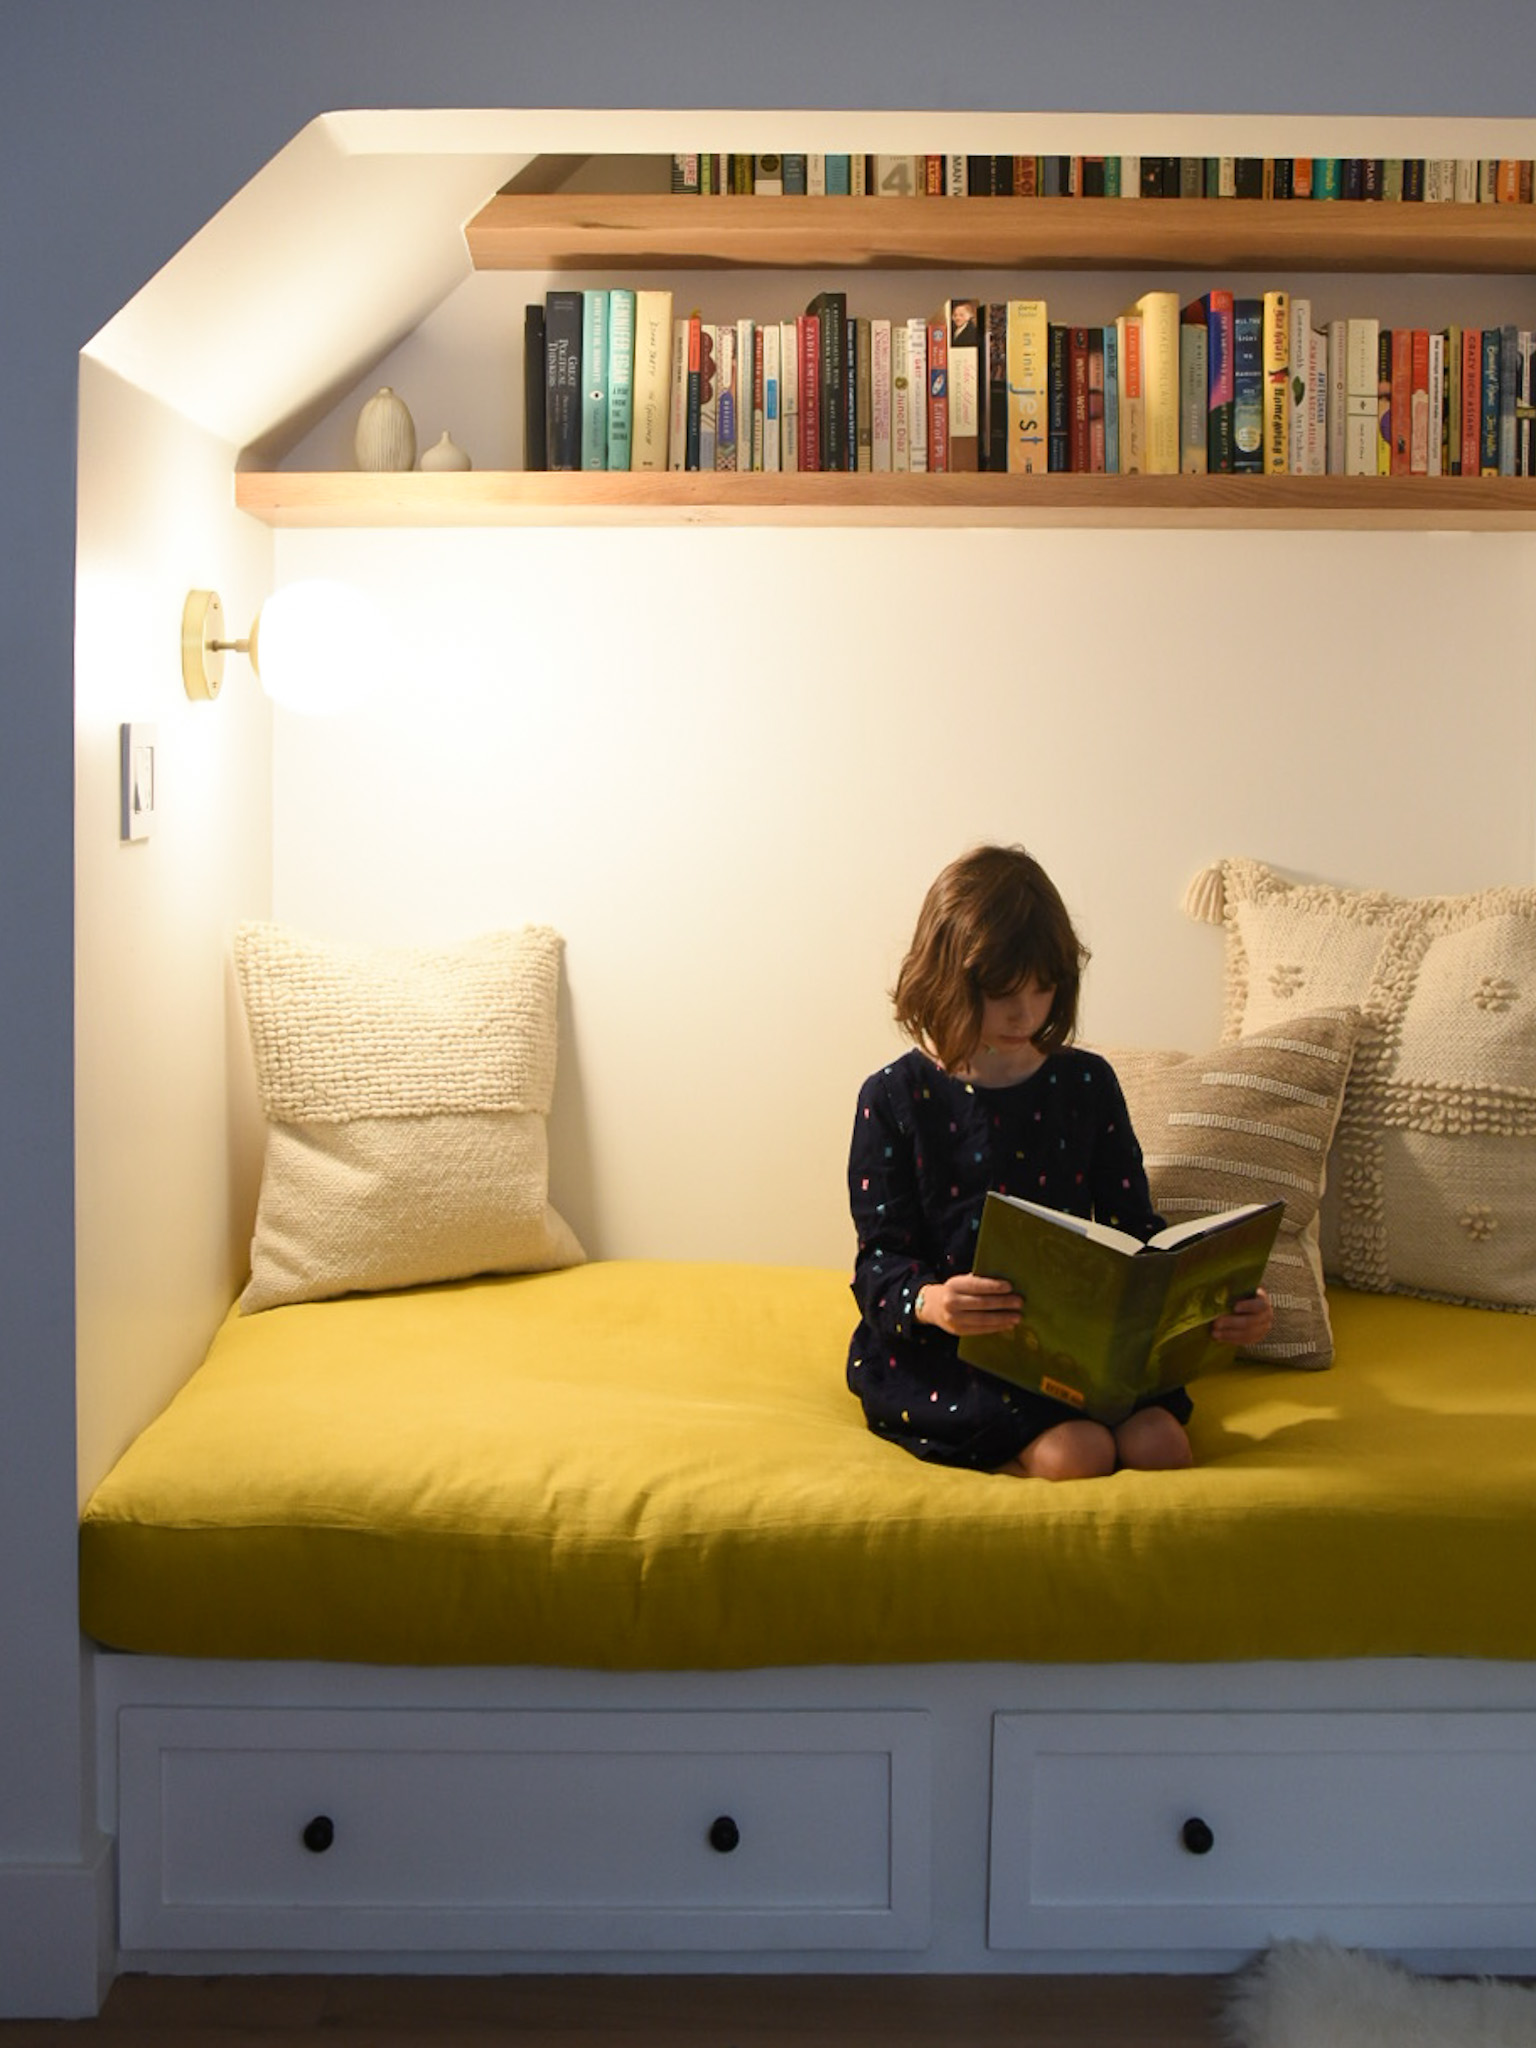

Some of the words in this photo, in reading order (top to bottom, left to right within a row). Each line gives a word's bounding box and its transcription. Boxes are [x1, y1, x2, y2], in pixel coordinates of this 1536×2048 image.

[881, 162, 913, 196] 4
[613, 294, 631, 348] JENNIFER
[1296, 307, 1305, 369] Commonwealth
[806, 326, 816, 358] ZADIE
[1468, 336, 1476, 370] CRAZY
[613, 353, 631, 384] EGAN
[806, 362, 816, 397] SMITH
[806, 410, 816, 424] ON
[934, 402, 944, 426] Life
[1466, 401, 1475, 438] ASIANS
[806, 429, 816, 470] BEAUTY
[934, 444, 944, 458] Pi
